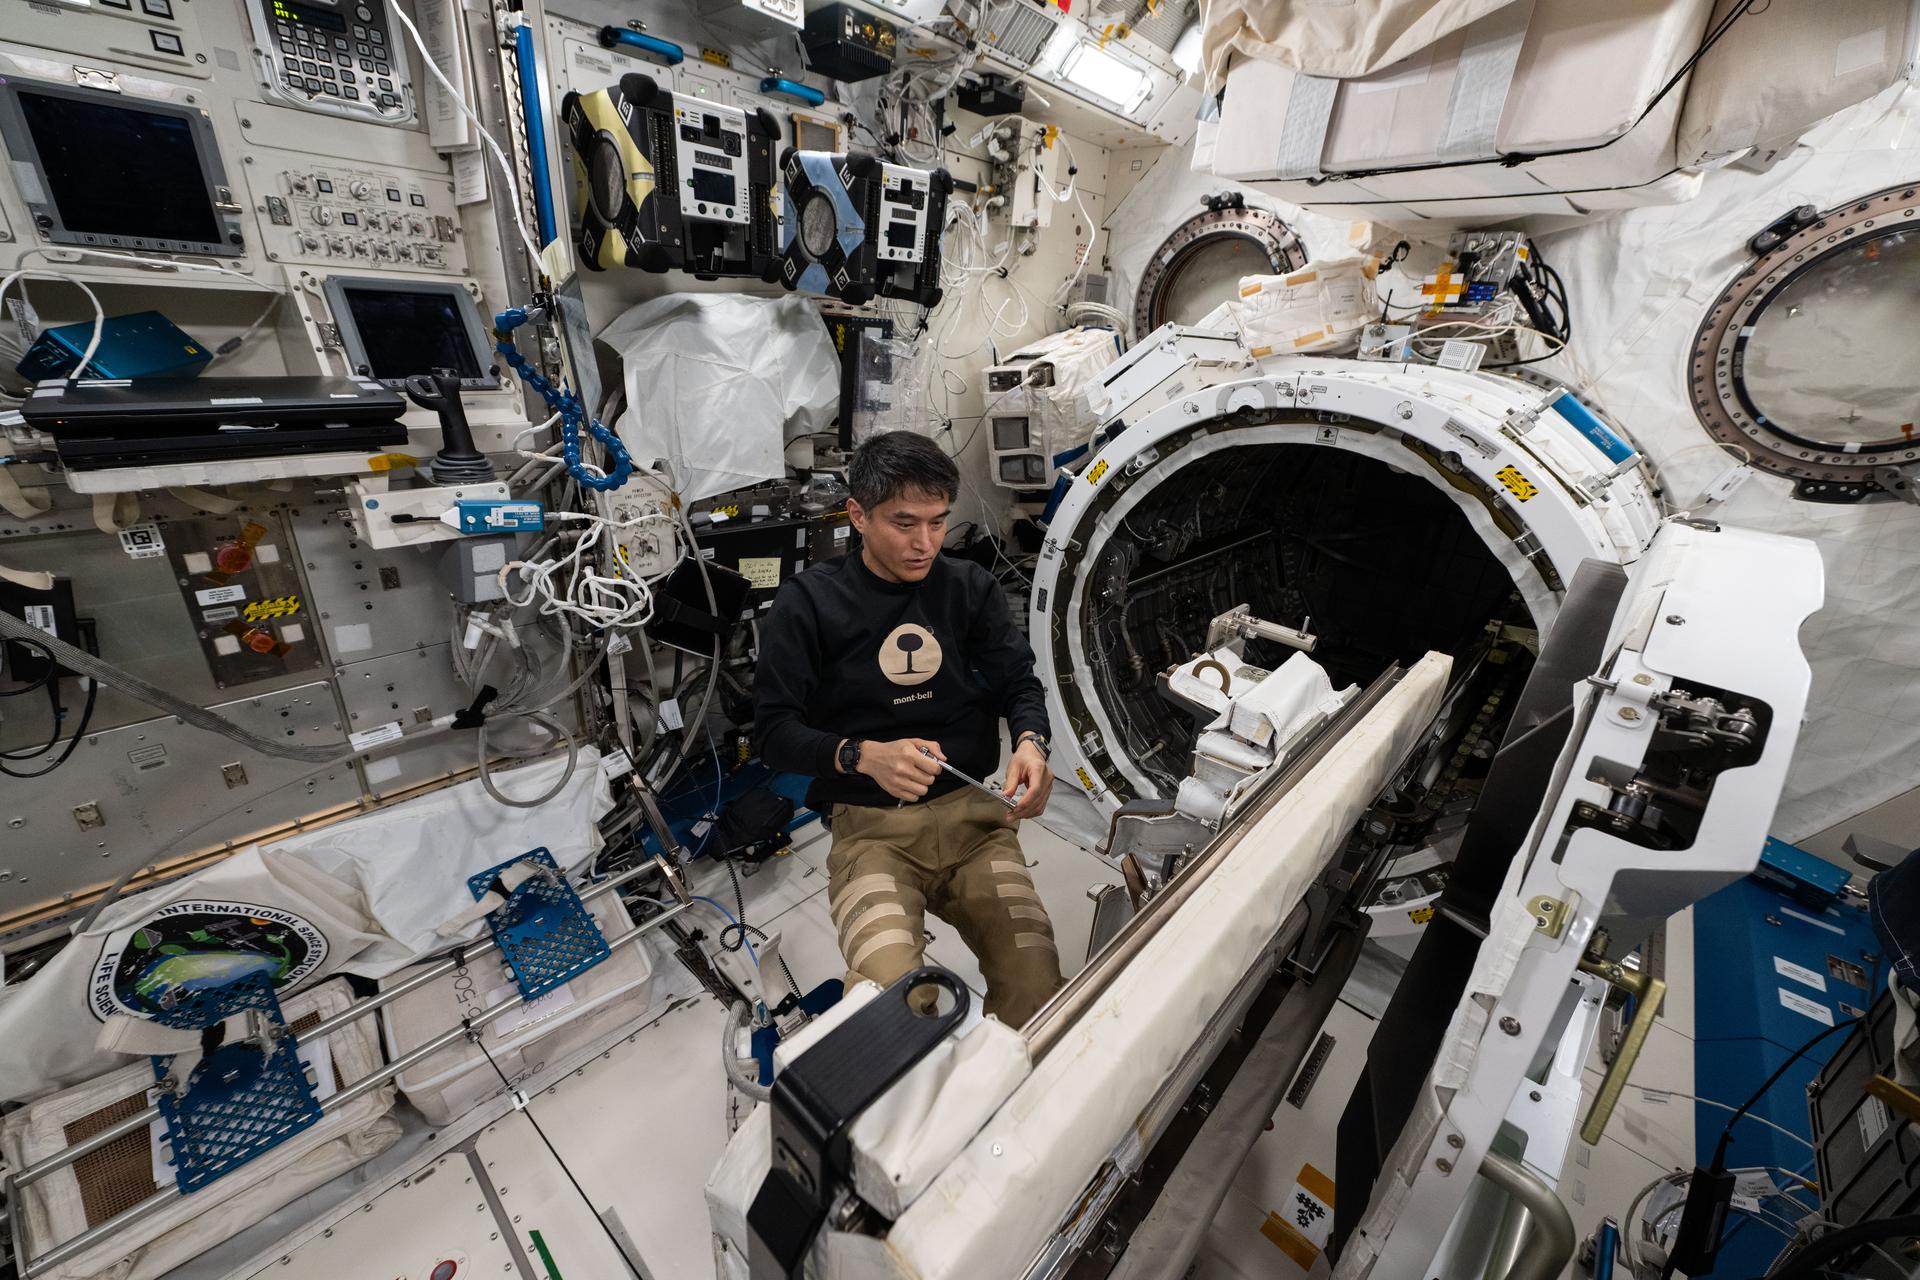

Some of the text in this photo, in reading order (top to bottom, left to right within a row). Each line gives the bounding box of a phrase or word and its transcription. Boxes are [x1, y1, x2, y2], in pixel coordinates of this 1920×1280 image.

[893, 691, 933, 705] mont-bell
[157, 902, 323, 984] INTERNATIONAL SPACE STATION
